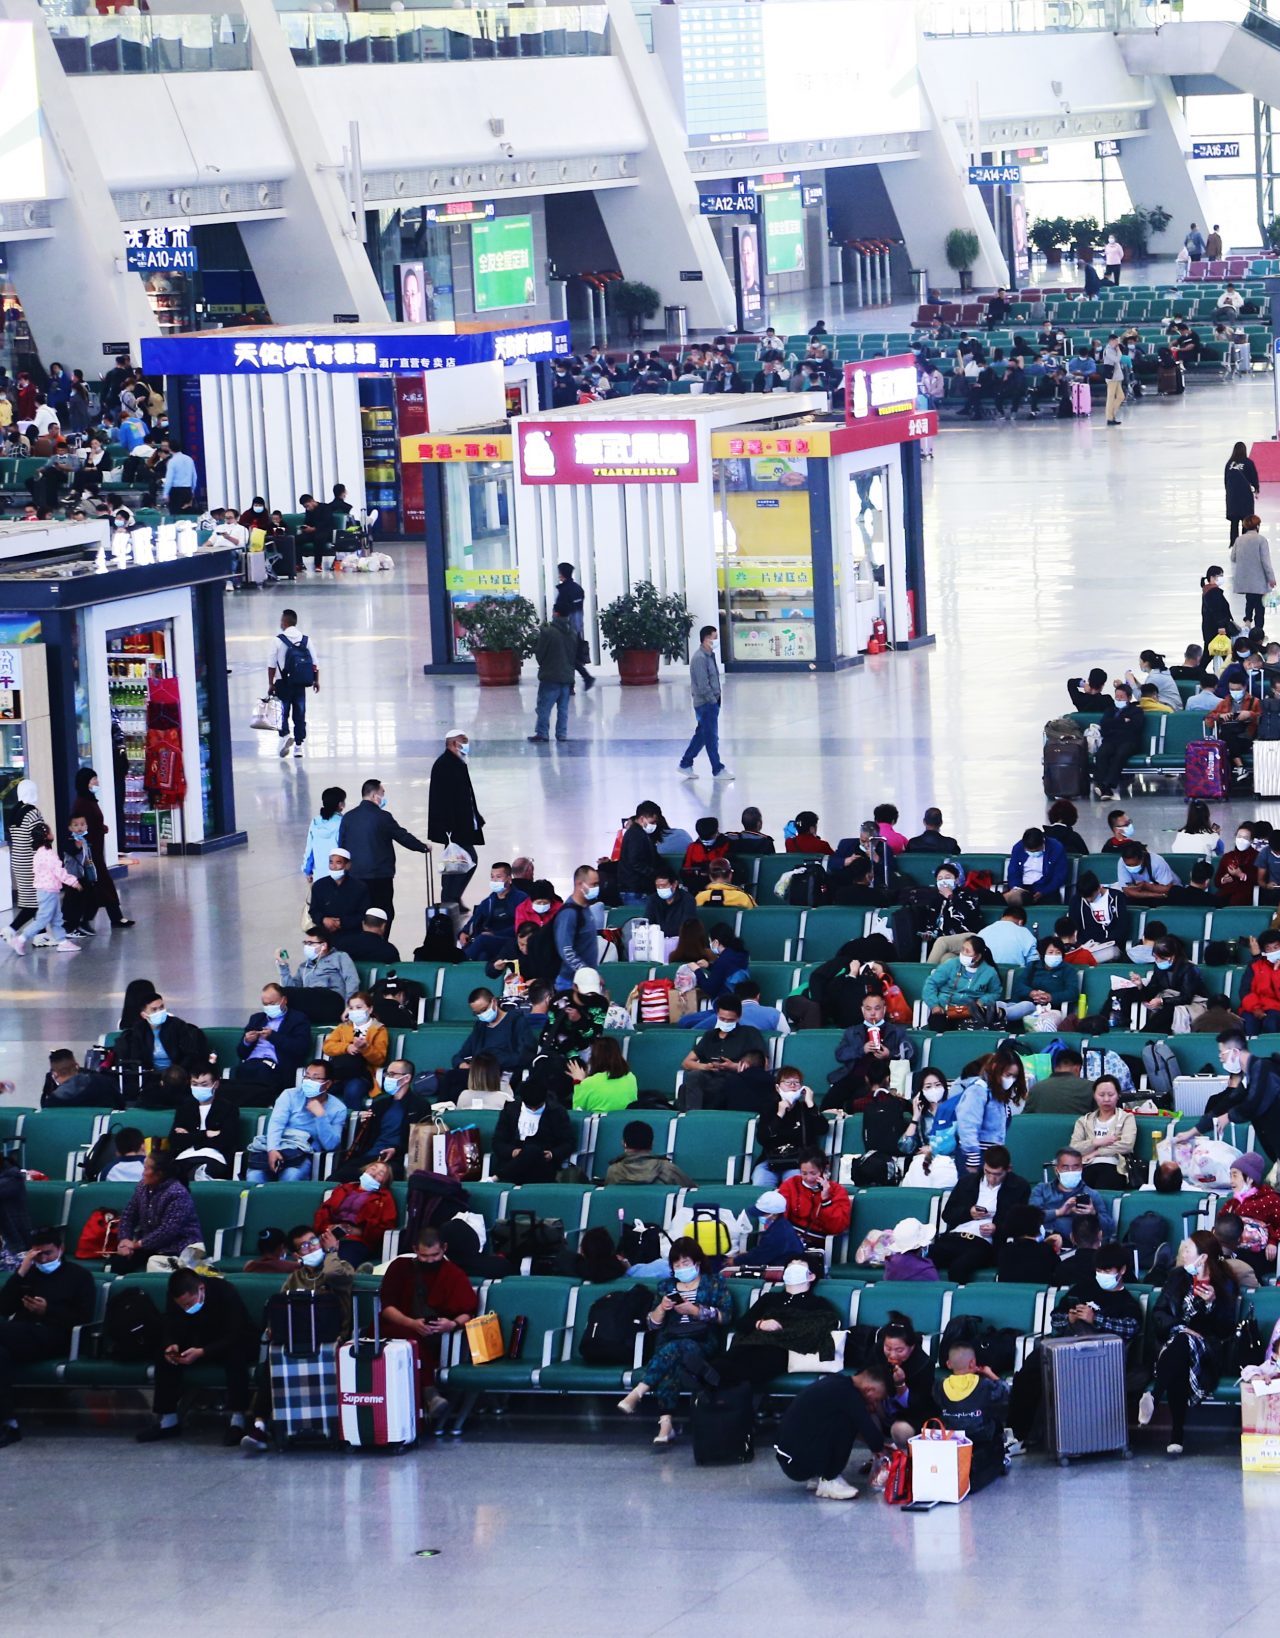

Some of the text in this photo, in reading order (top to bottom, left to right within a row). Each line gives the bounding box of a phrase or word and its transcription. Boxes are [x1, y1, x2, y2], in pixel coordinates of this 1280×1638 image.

[1206, 144, 1239, 157] A16-A17
[983, 169, 1020, 181] A14-A15
[716, 197, 754, 210] A12-A13
[148, 251, 194, 267] A10-A11
[343, 1393, 384, 1404] Supreme
